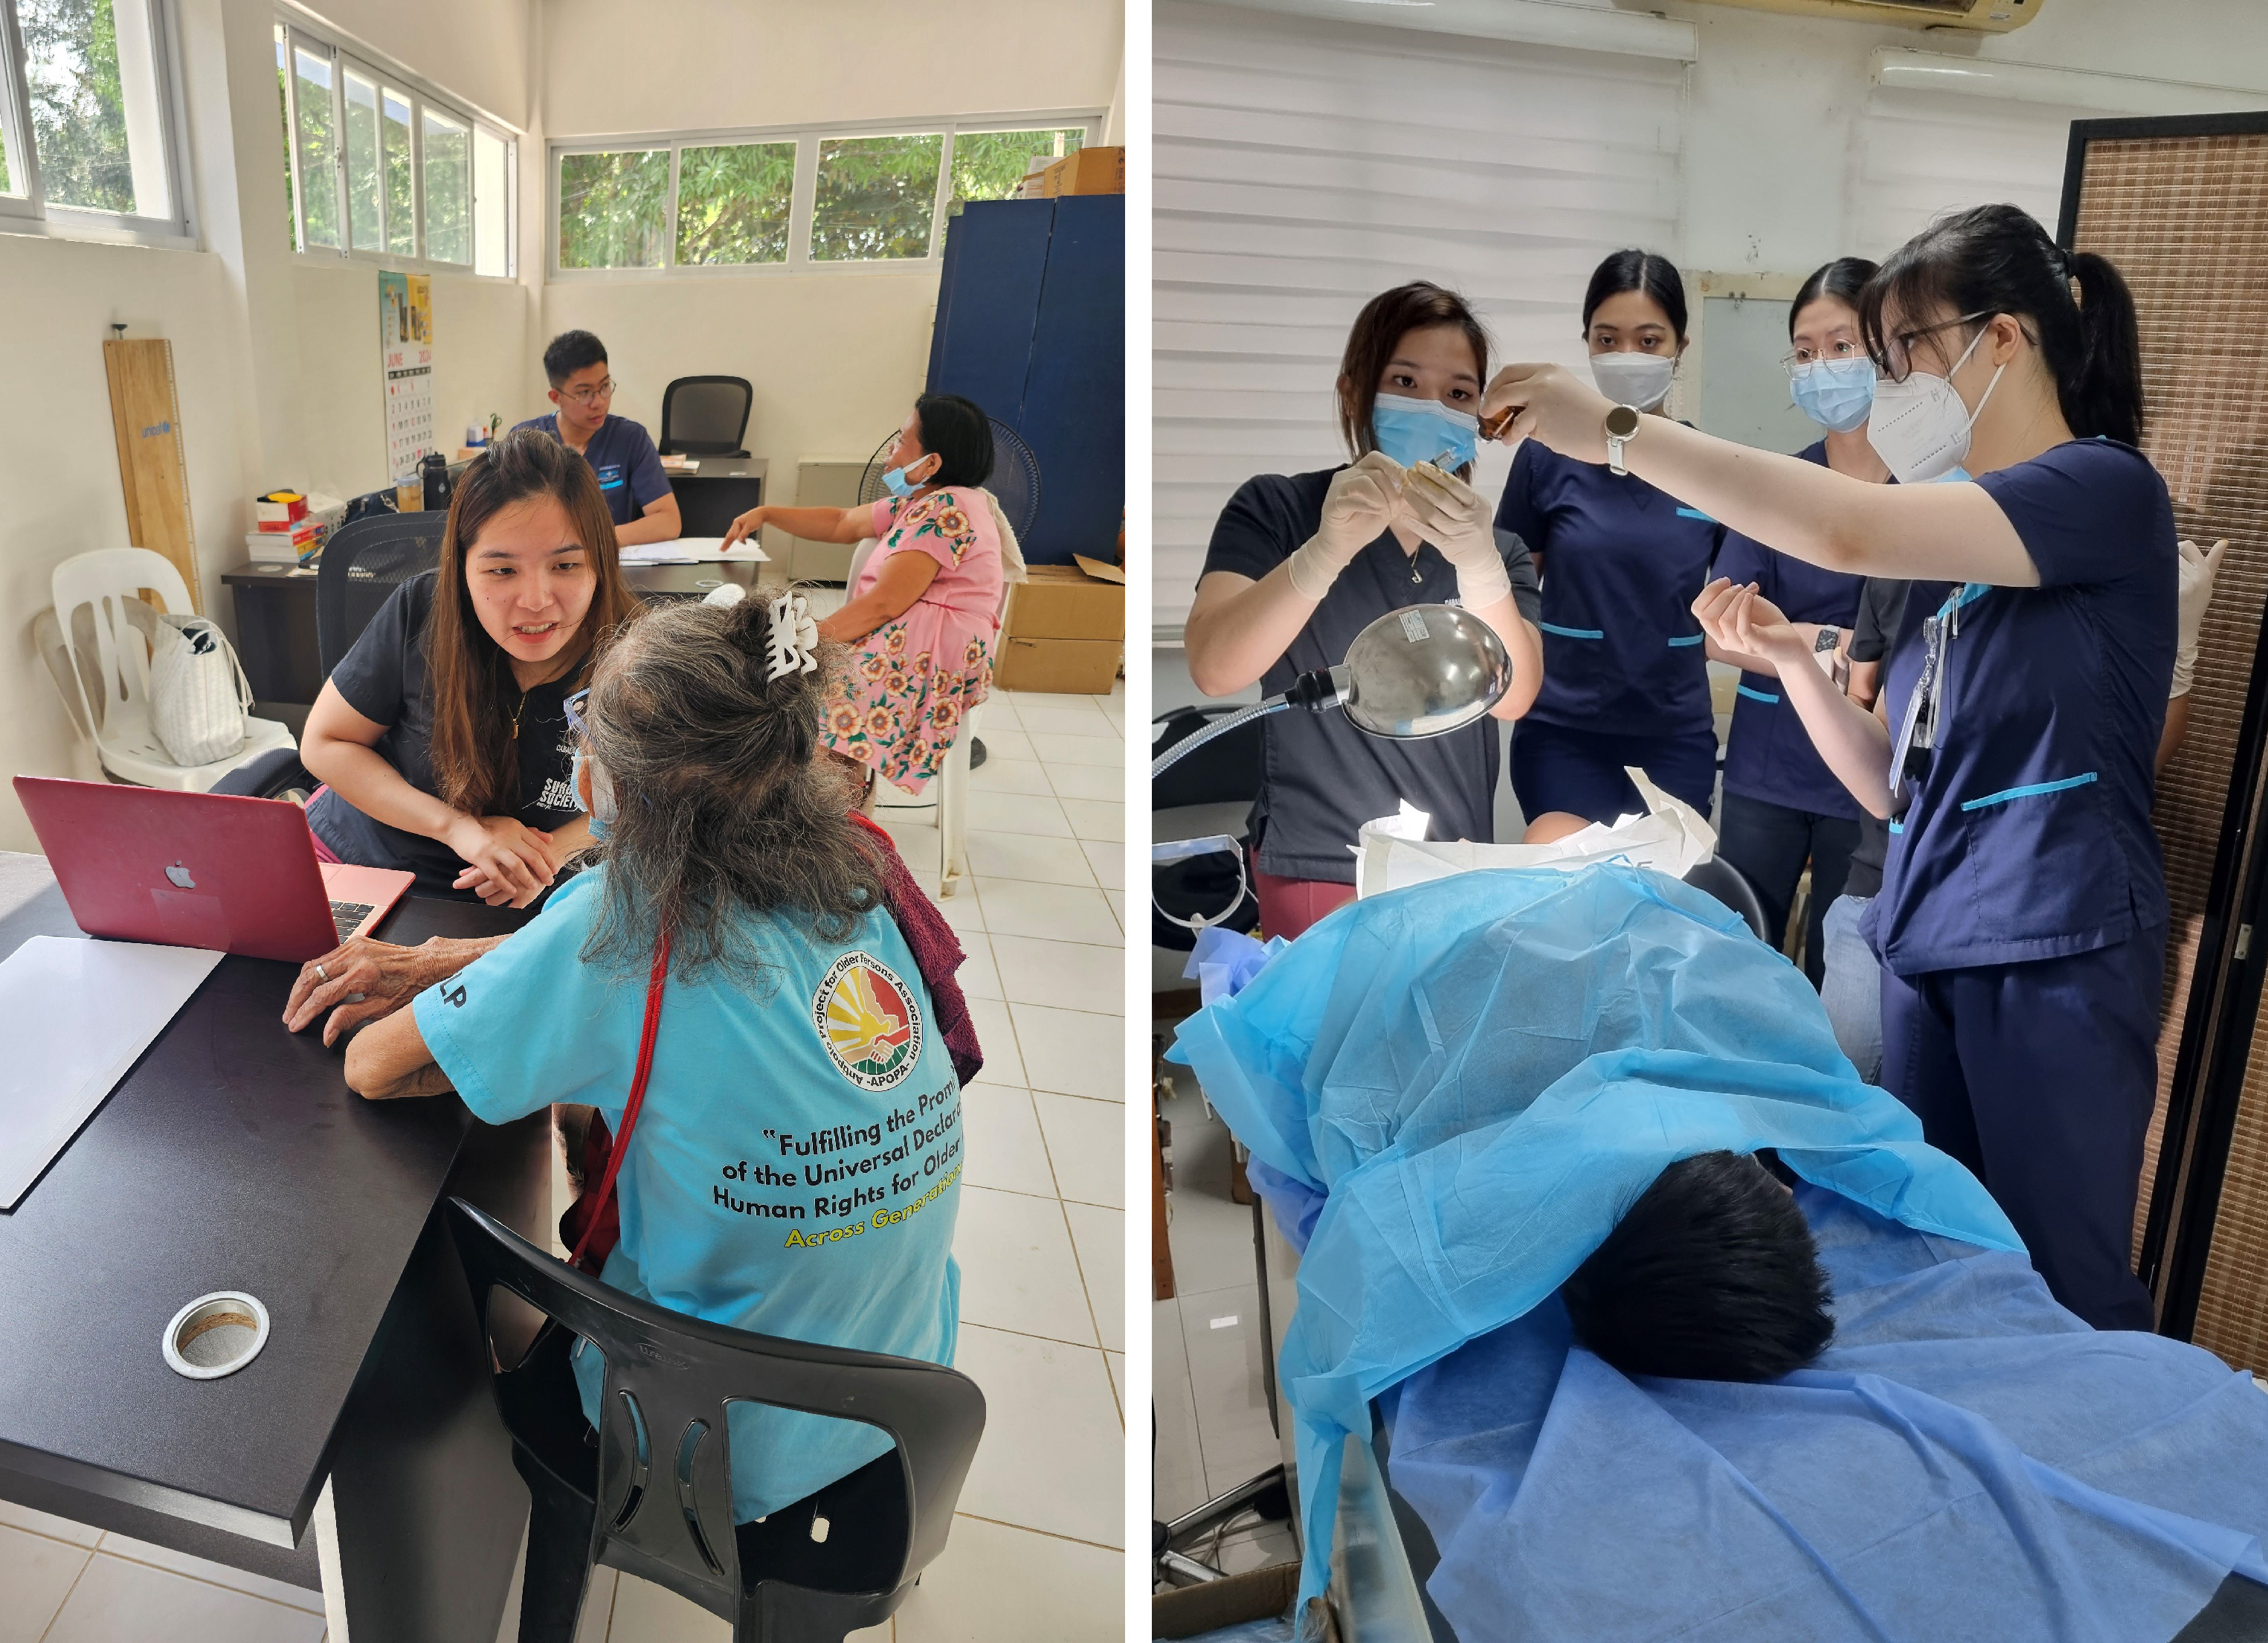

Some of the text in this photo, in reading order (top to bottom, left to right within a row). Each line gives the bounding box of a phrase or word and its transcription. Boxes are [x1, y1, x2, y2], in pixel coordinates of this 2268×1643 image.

[388, 350, 431, 367] JUNE 2024
[142, 422, 162, 438] unicef
[815, 953, 921, 1085] Antipolo Project for Older Persons Association
[886, 1108, 915, 1133] the
[722, 1160, 747, 1182] of
[754, 1164, 797, 1186] the
[805, 1135, 910, 1186] Universal
[712, 1185, 805, 1219] Human
[814, 1186, 886, 1218] Rights
[892, 1172, 920, 1195] for
[923, 1136, 961, 1177] Older
[784, 1221, 865, 1248] Across
